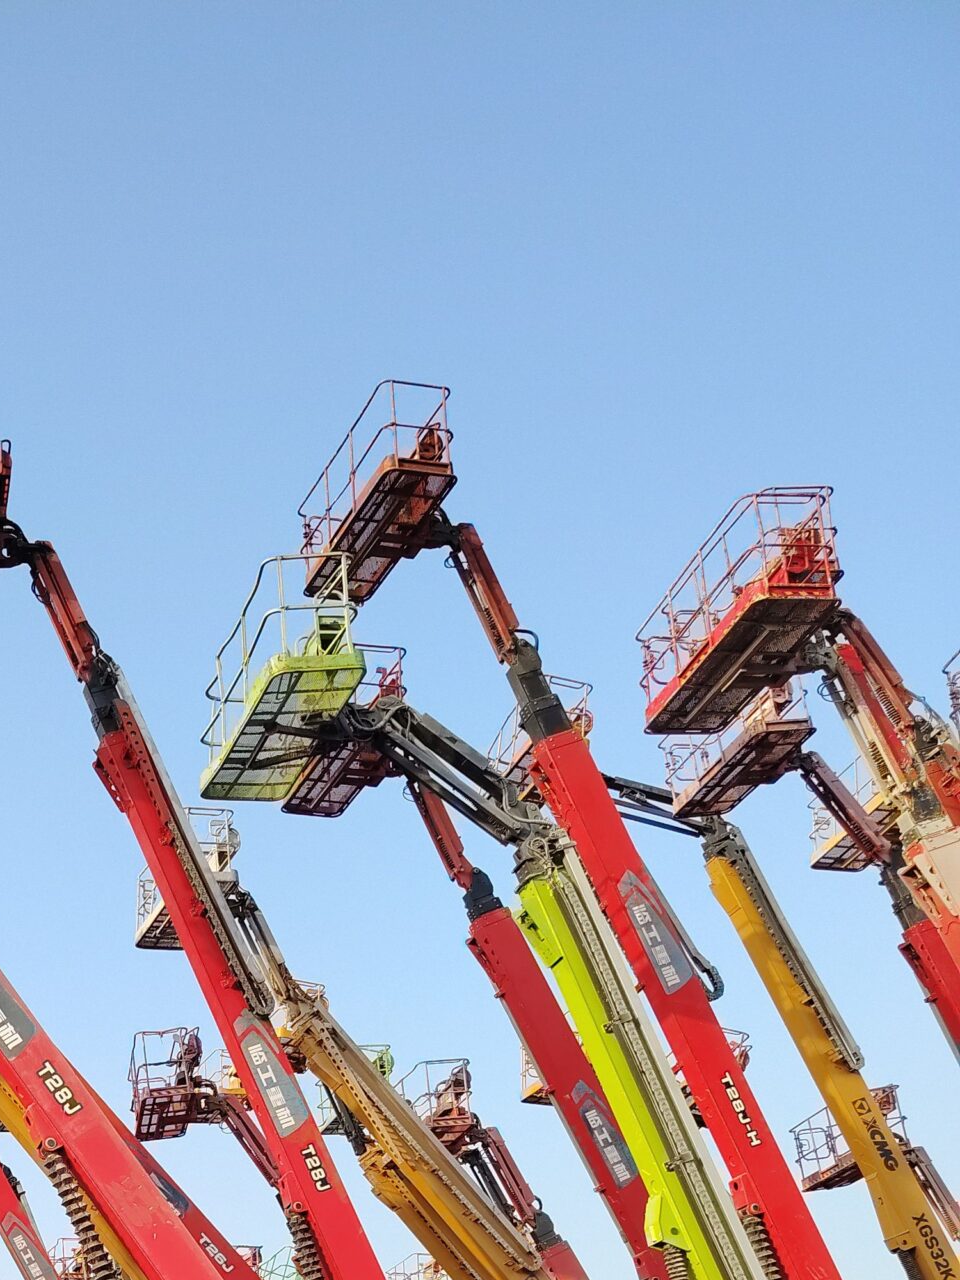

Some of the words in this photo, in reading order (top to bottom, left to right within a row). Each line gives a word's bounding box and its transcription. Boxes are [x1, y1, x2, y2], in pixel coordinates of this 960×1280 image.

[632, 904, 679, 985] 临工重机
[36, 1060, 82, 1116] T28J
[246, 1043, 293, 1128] 临工重机
[719, 1072, 762, 1147] T28J-H
[300, 1144, 331, 1192] T28J
[583, 1108, 631, 1182] 临工重机
[861, 1118, 899, 1172] XCMG
[199, 1232, 234, 1272] T26J
